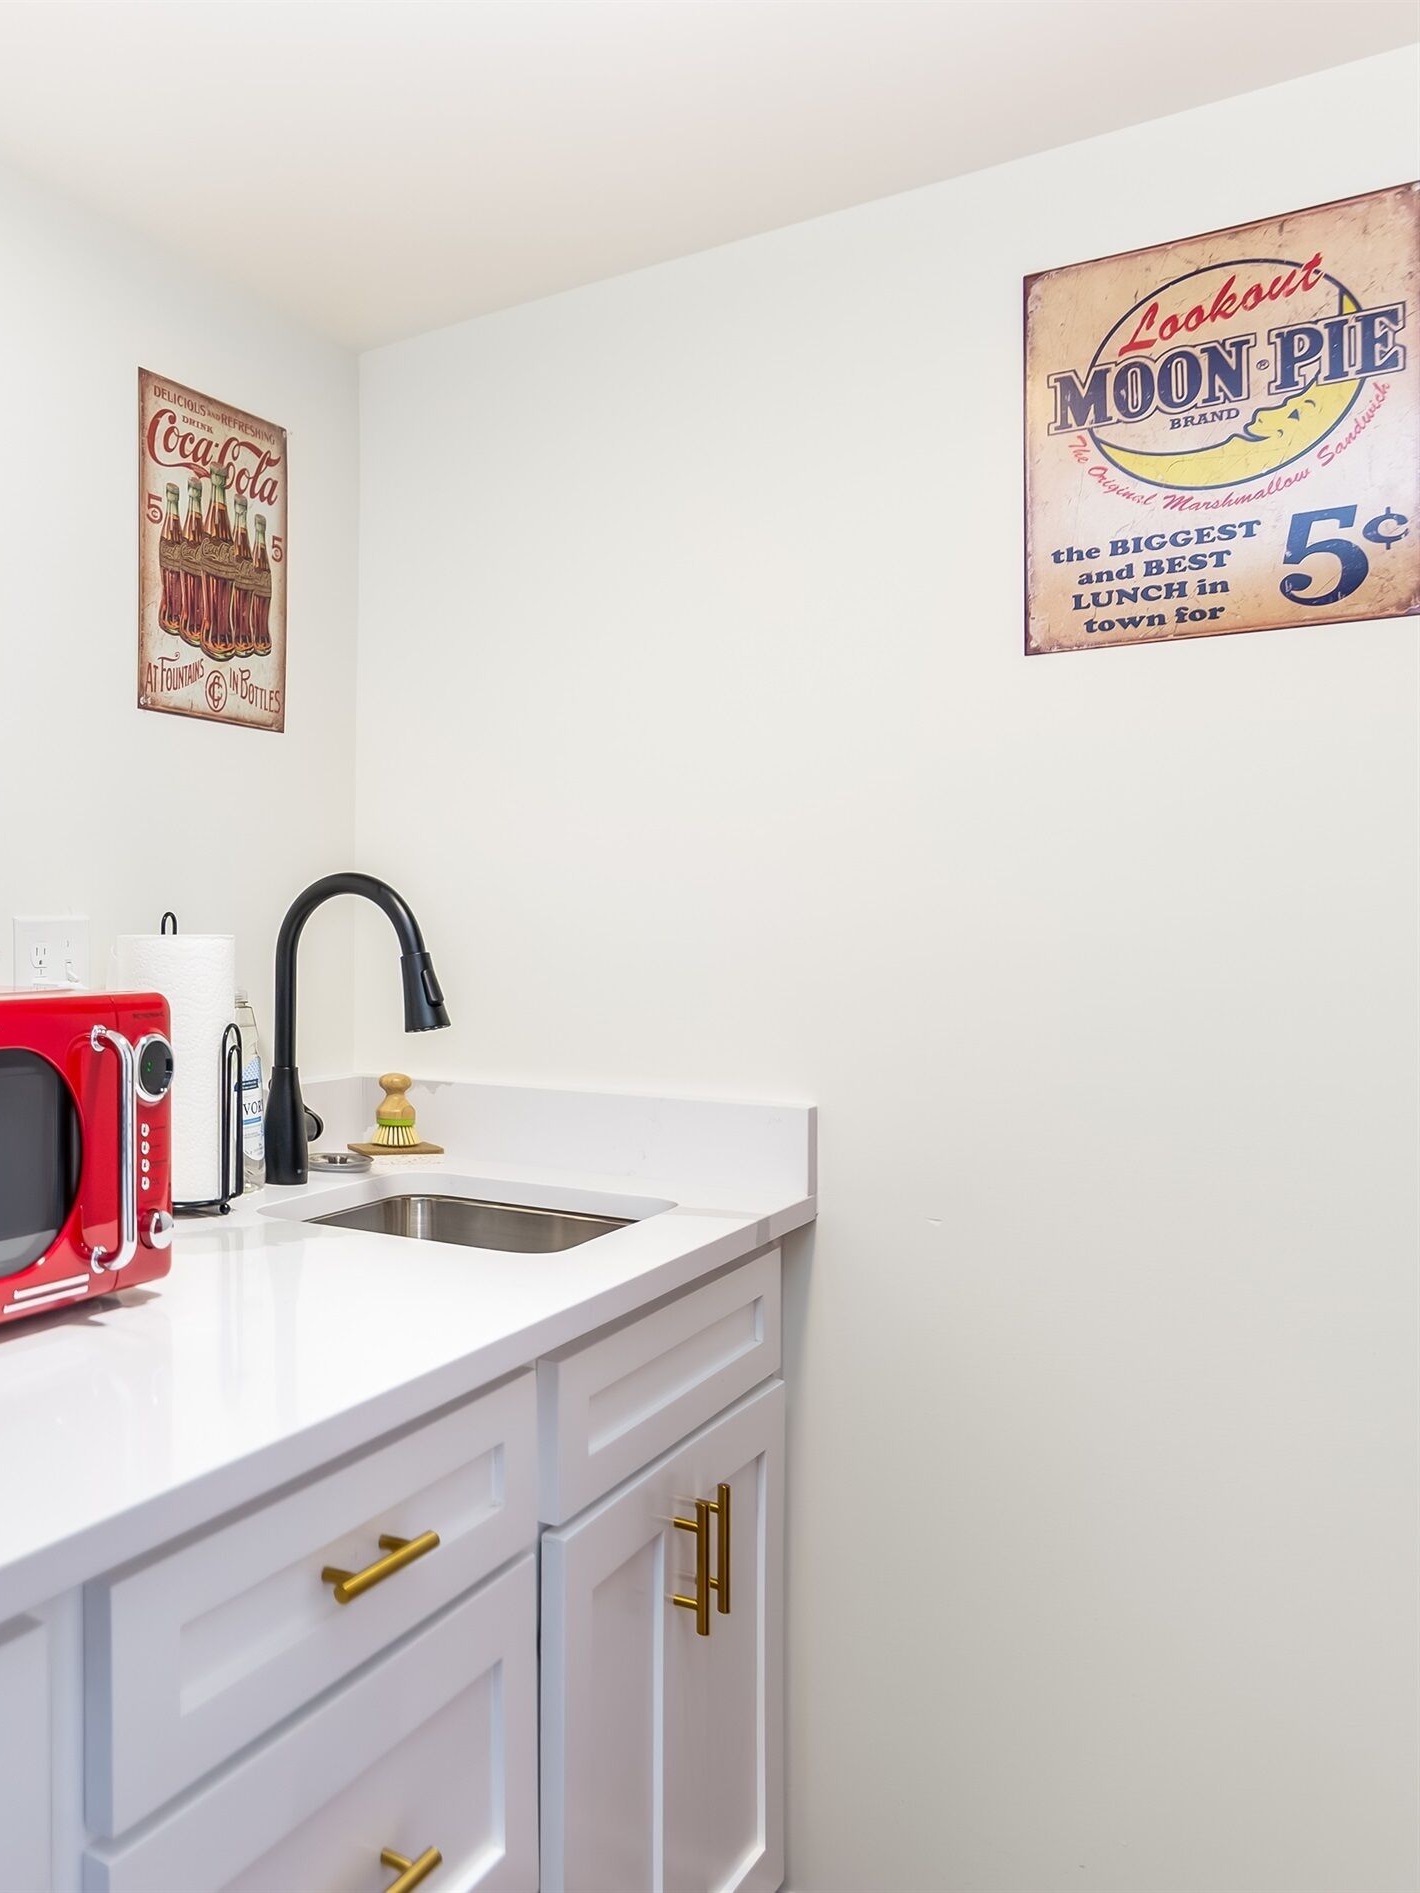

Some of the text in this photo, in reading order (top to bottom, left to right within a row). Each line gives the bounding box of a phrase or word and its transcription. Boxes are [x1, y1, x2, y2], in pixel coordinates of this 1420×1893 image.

[1118, 252, 1324, 357] Lookout
[1048, 302, 1407, 435] MOON PIE
[153, 384, 207, 417] DELICIOUS
[221, 413, 276, 446] REFRESHING
[181, 415, 214, 435] DRINK
[1168, 407, 1240, 430] BRAND
[1068, 381, 1391, 512] The Original Marshmallow Sandwich
[1051, 520, 1262, 564] the BIGGEST
[1077, 549, 1232, 585] and BEST
[1071, 578, 1230, 610] LUNCH in
[1083, 606, 1226, 633] town for
[145, 652, 205, 693] AT FOUNTAINS
[229, 667, 281, 714] IN BOTTLES
